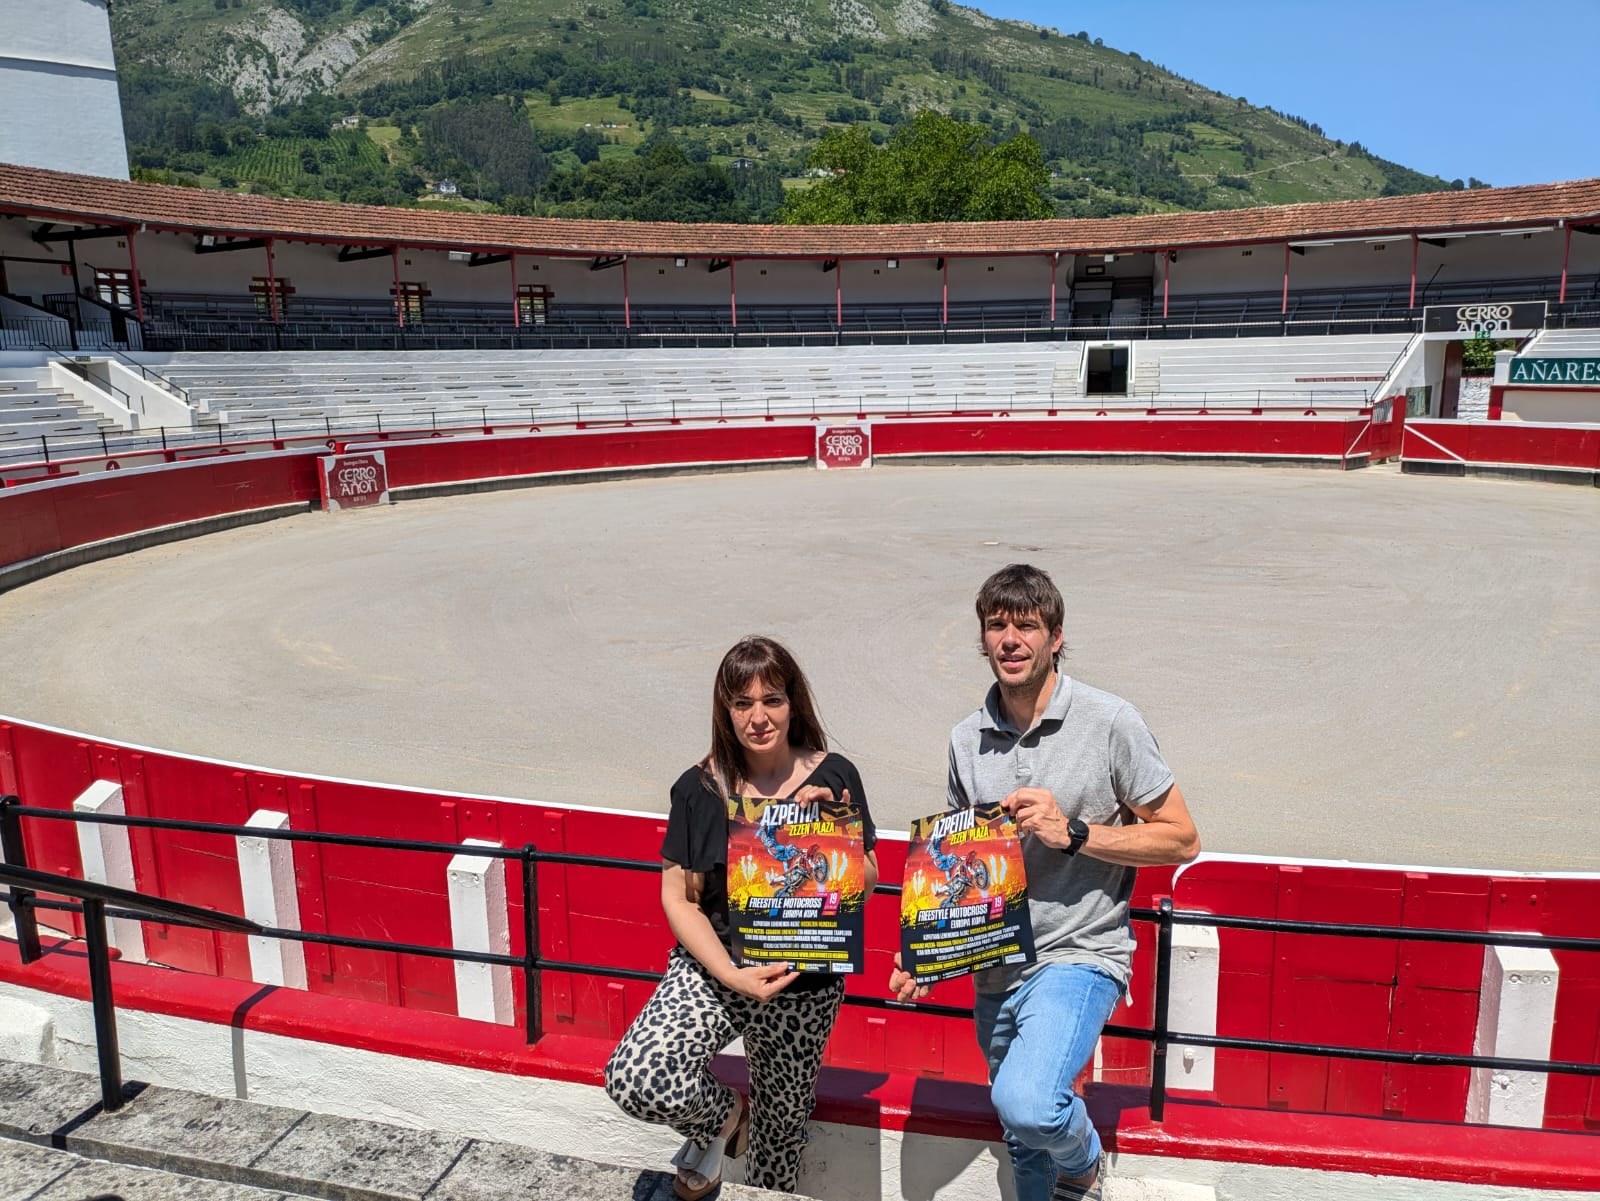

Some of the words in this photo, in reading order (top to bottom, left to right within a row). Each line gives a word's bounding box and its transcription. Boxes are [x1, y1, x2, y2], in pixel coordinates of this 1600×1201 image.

[1456, 305, 1512, 321] CERRO
[328, 442, 336, 452] 2
[826, 435, 863, 446] CERRO
[338, 466, 377, 482] CERRO
[788, 824, 810, 837] ZEZEN
[813, 821, 835, 835] PLAZA
[931, 808, 976, 841] AZPEITIA
[950, 832, 967, 846] ZEZEN
[969, 826, 990, 841] PLAZA
[749, 897, 784, 909] FREESTYLE
[783, 897, 823, 909] MOTOCROSS
[829, 893, 837, 905] 19
[994, 897, 1002, 908] 19
[918, 907, 949, 922] FREESTYLE
[949, 904, 988, 919] MOTOCROSS
[950, 918, 971, 930] EUROPA
